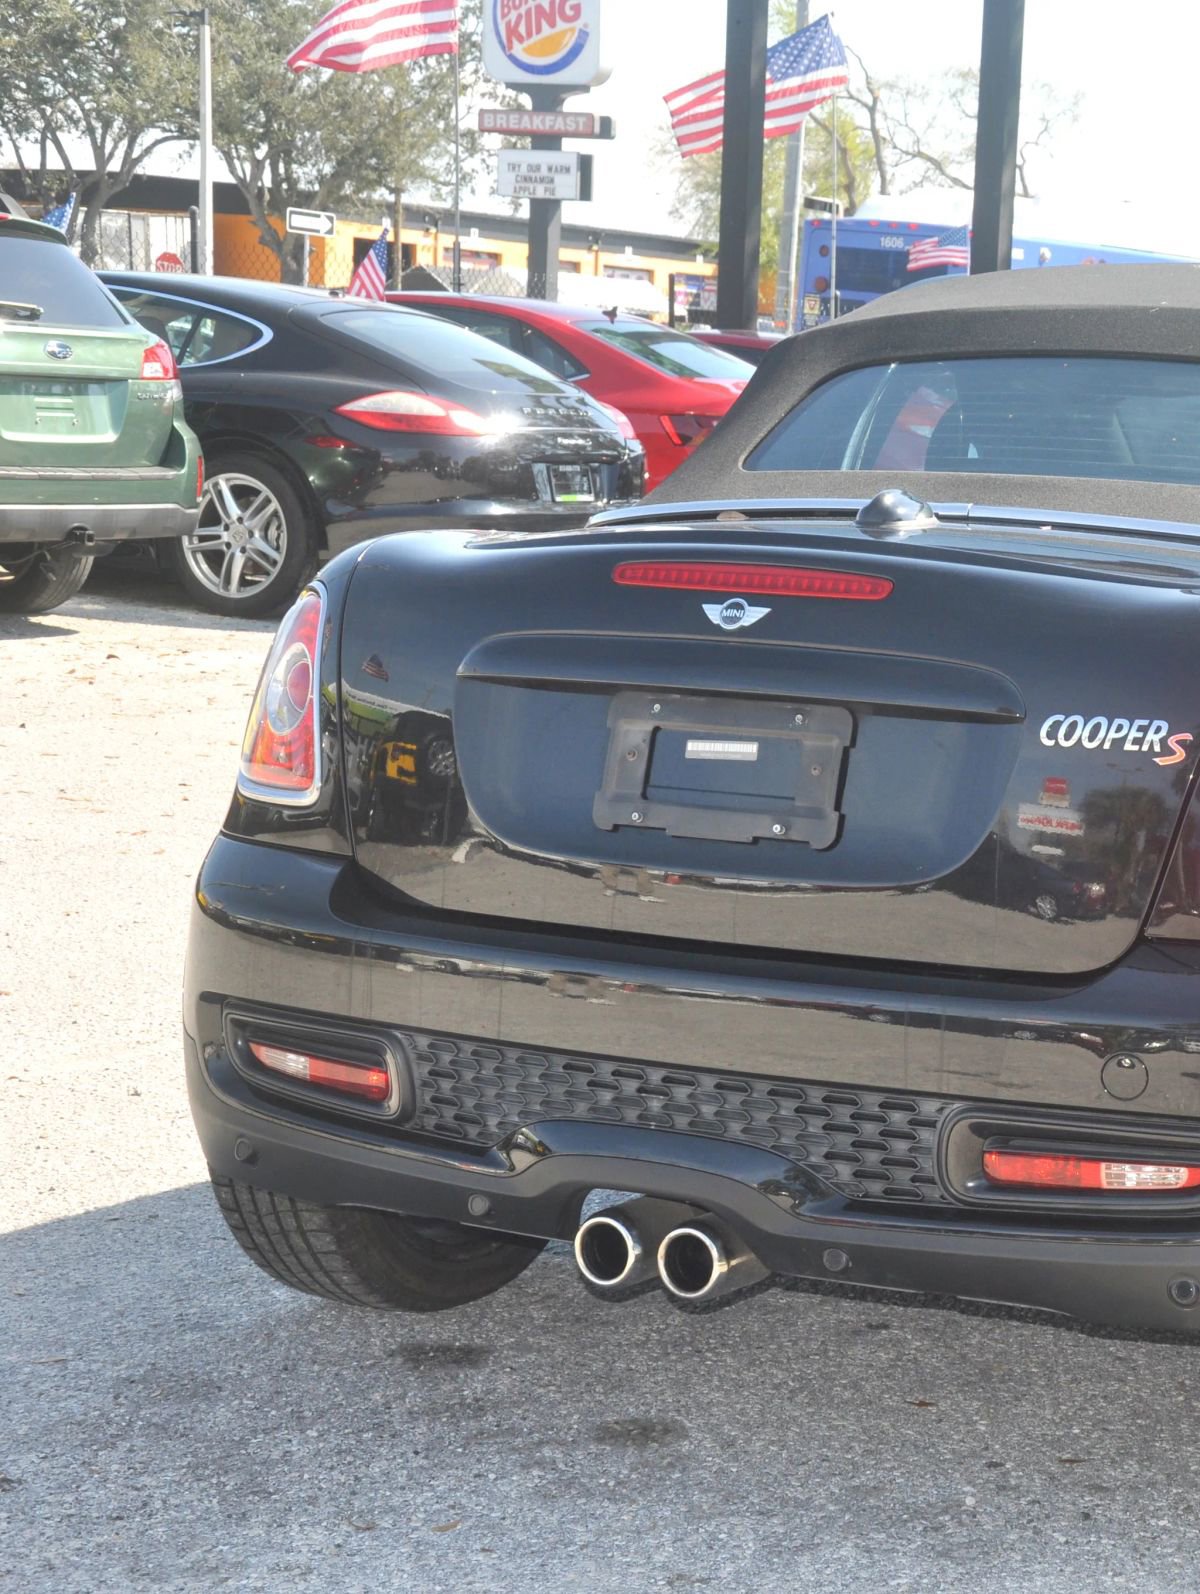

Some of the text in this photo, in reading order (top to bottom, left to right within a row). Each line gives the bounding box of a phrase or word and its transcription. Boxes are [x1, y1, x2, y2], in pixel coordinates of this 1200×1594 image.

[505, 0, 582, 52] KING
[483, 112, 588, 132] BREAKFAST
[507, 162, 571, 174] TRY OUR WARM
[515, 174, 555, 184] CINNAMON
[513, 186, 556, 196] APPLE PIE
[880, 236, 904, 249] 1606
[156, 260, 183, 272] STOP
[721, 608, 745, 618] MINI
[1039, 714, 1194, 766] COOPER S
